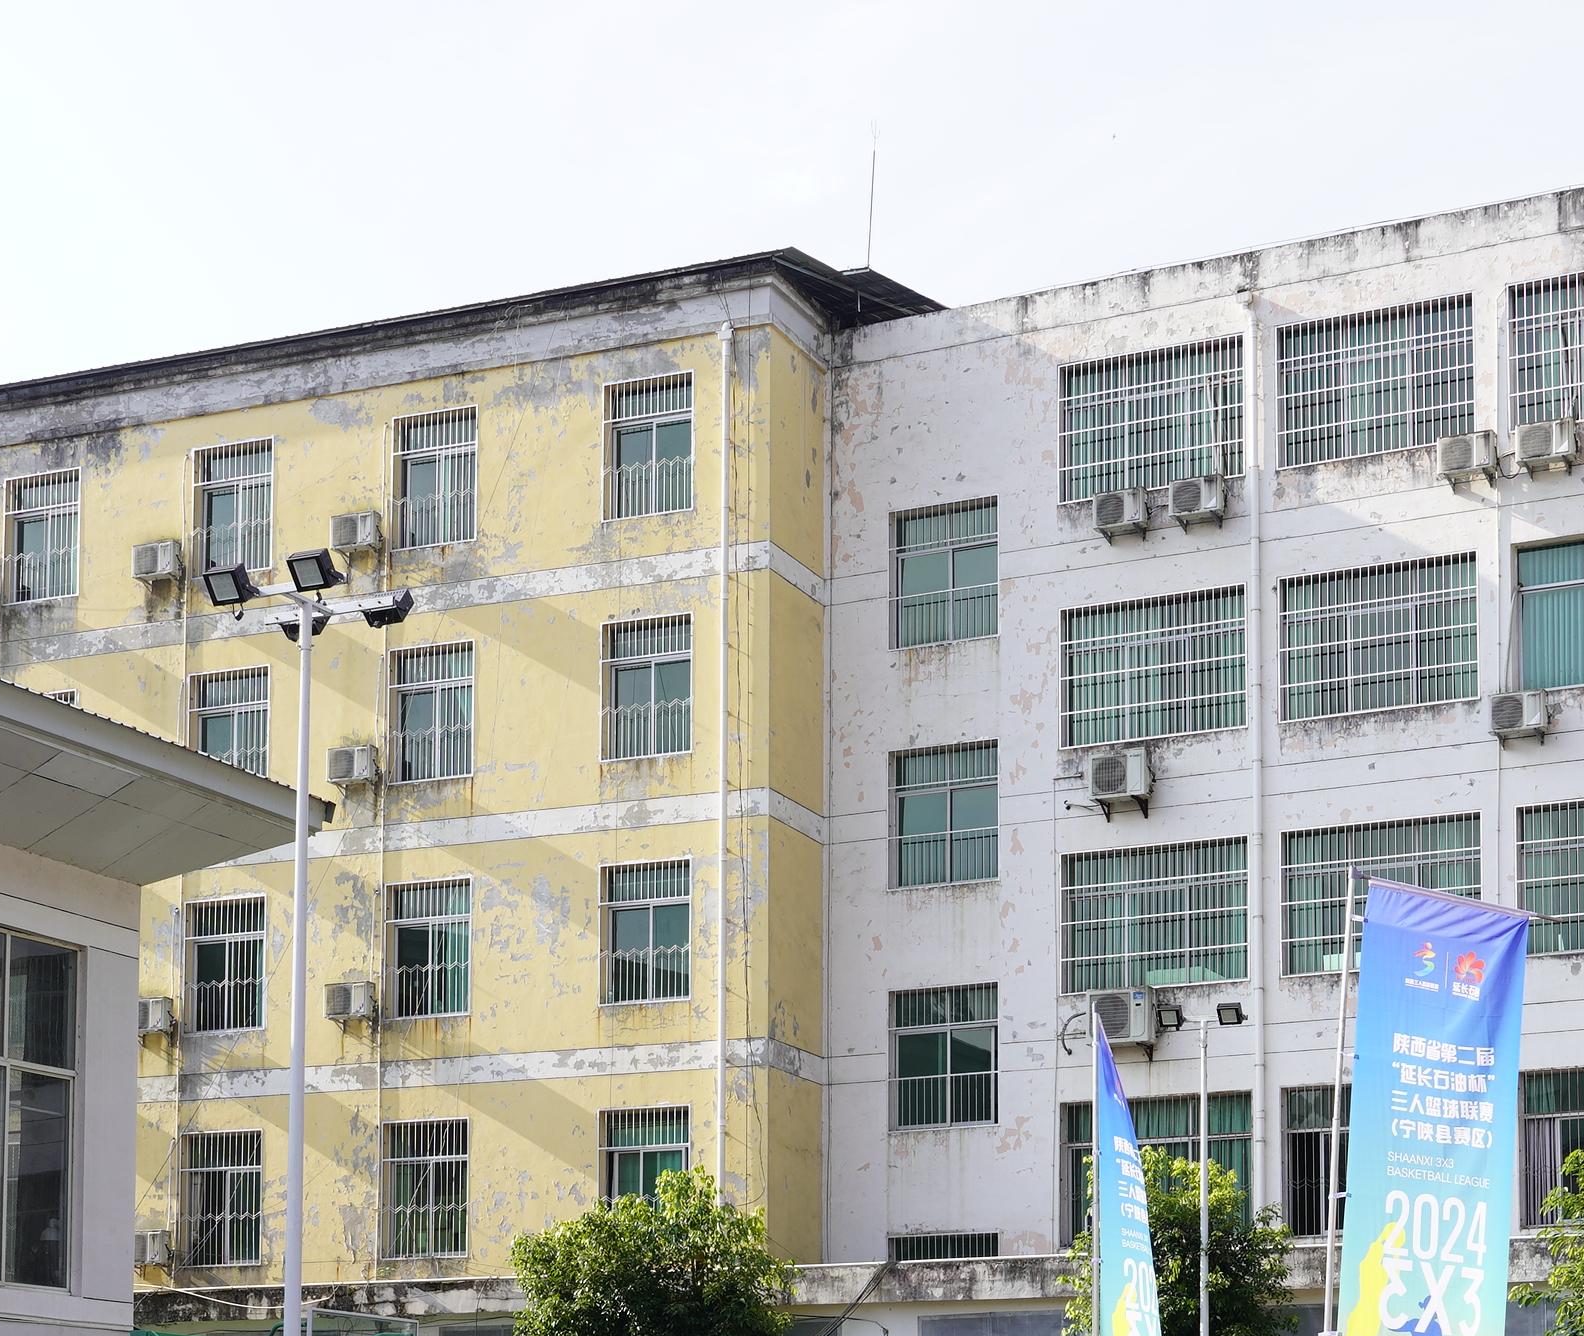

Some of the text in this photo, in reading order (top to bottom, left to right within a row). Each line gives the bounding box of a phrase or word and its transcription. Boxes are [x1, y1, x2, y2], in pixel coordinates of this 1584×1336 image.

[1393, 1032, 1495, 1067] 陕西省第二届
[1392, 1062, 1495, 1094] “延长石油杯”
[1391, 1090, 1494, 1124] 三人篮球联赛
[1387, 1151, 1434, 1167] SHAANXI
[1386, 1166, 1490, 1189] BASKETBALL LEAGUE
[1383, 1190, 1488, 1266] 2024
